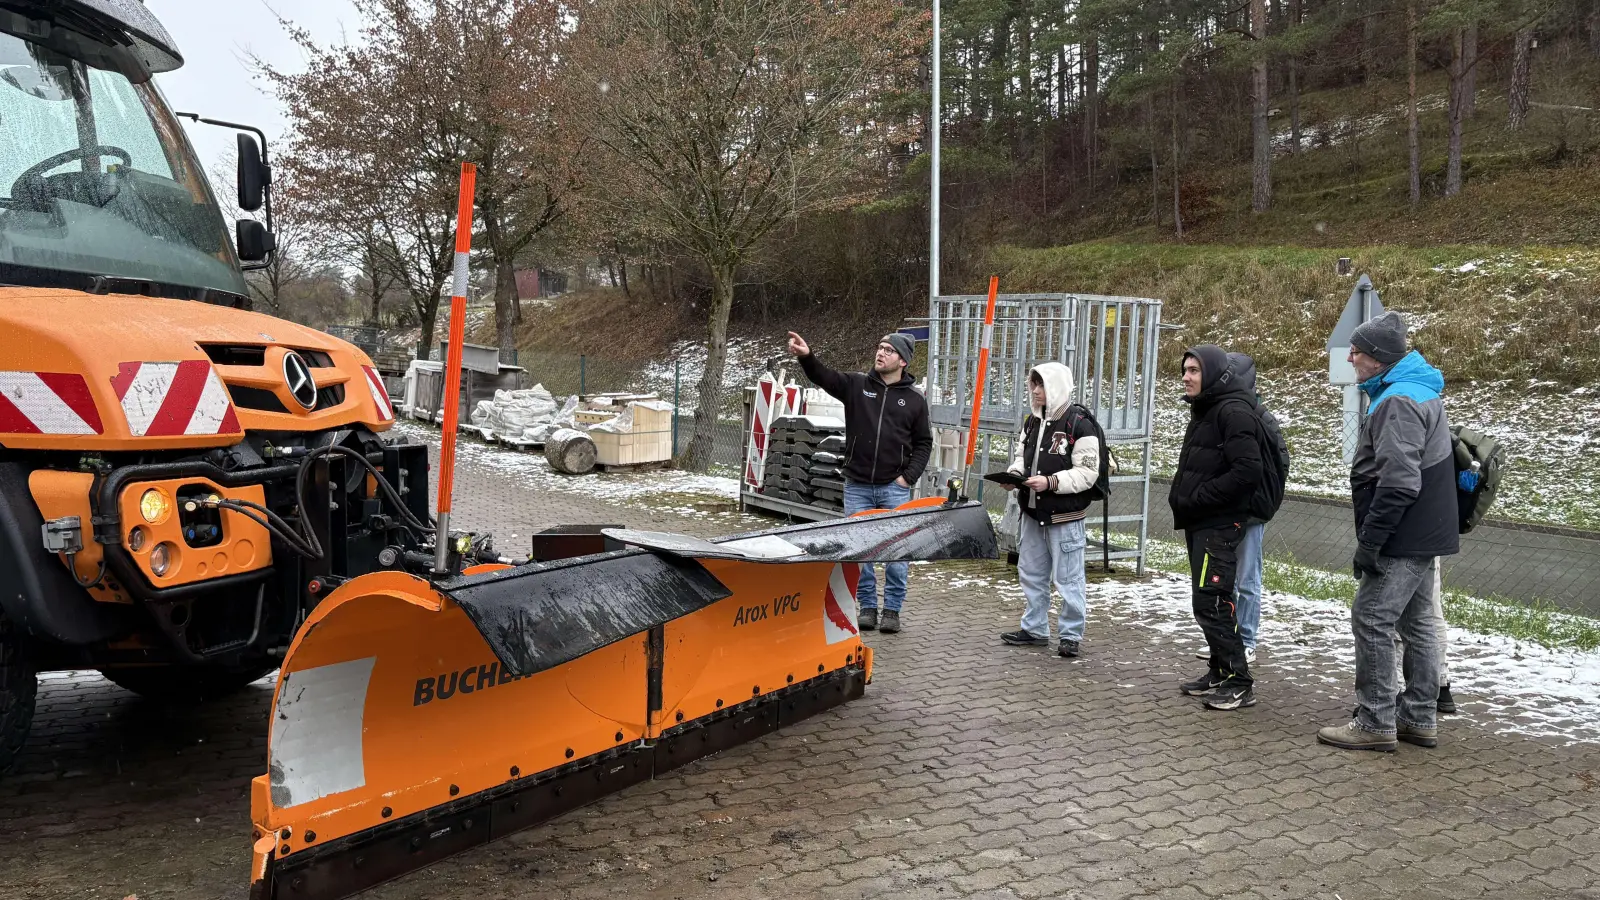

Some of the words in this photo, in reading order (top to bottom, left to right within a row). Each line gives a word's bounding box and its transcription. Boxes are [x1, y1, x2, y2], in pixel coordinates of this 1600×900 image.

[733, 604, 769, 627] Arox
[773, 592, 802, 617] VPG
[413, 661, 533, 707] BUCHE
